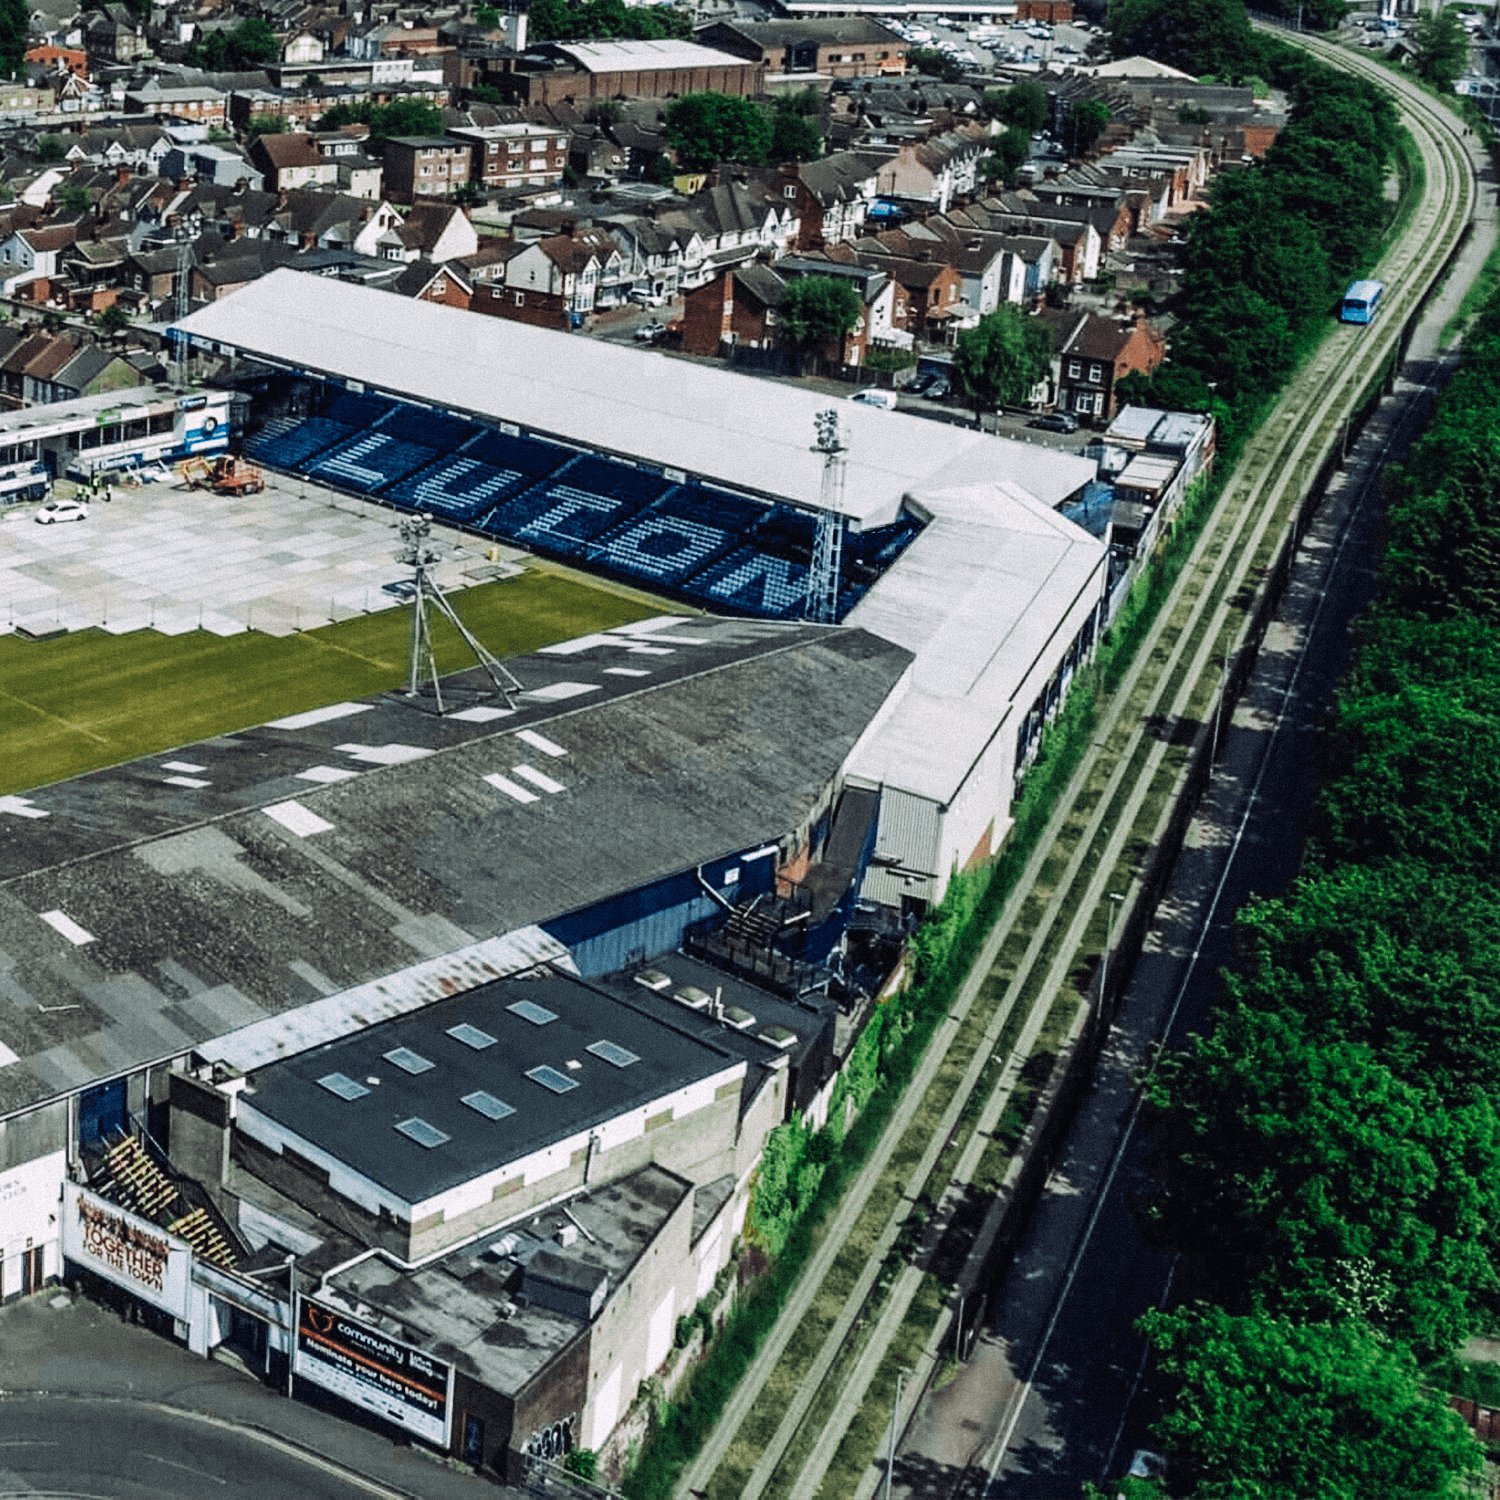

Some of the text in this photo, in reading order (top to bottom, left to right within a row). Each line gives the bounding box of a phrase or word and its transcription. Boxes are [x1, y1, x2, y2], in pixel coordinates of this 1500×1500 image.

[314, 431, 812, 612] LUTON
[83, 1240, 163, 1291] FOR THE TOWN
[85, 1222, 163, 1276] TOGETHER
[337, 1322, 404, 1364] community
[306, 1338, 353, 1367] Nominate
[355, 1363, 378, 1379] your
[380, 1373, 403, 1391] hero
[404, 1386, 438, 1410] today!
